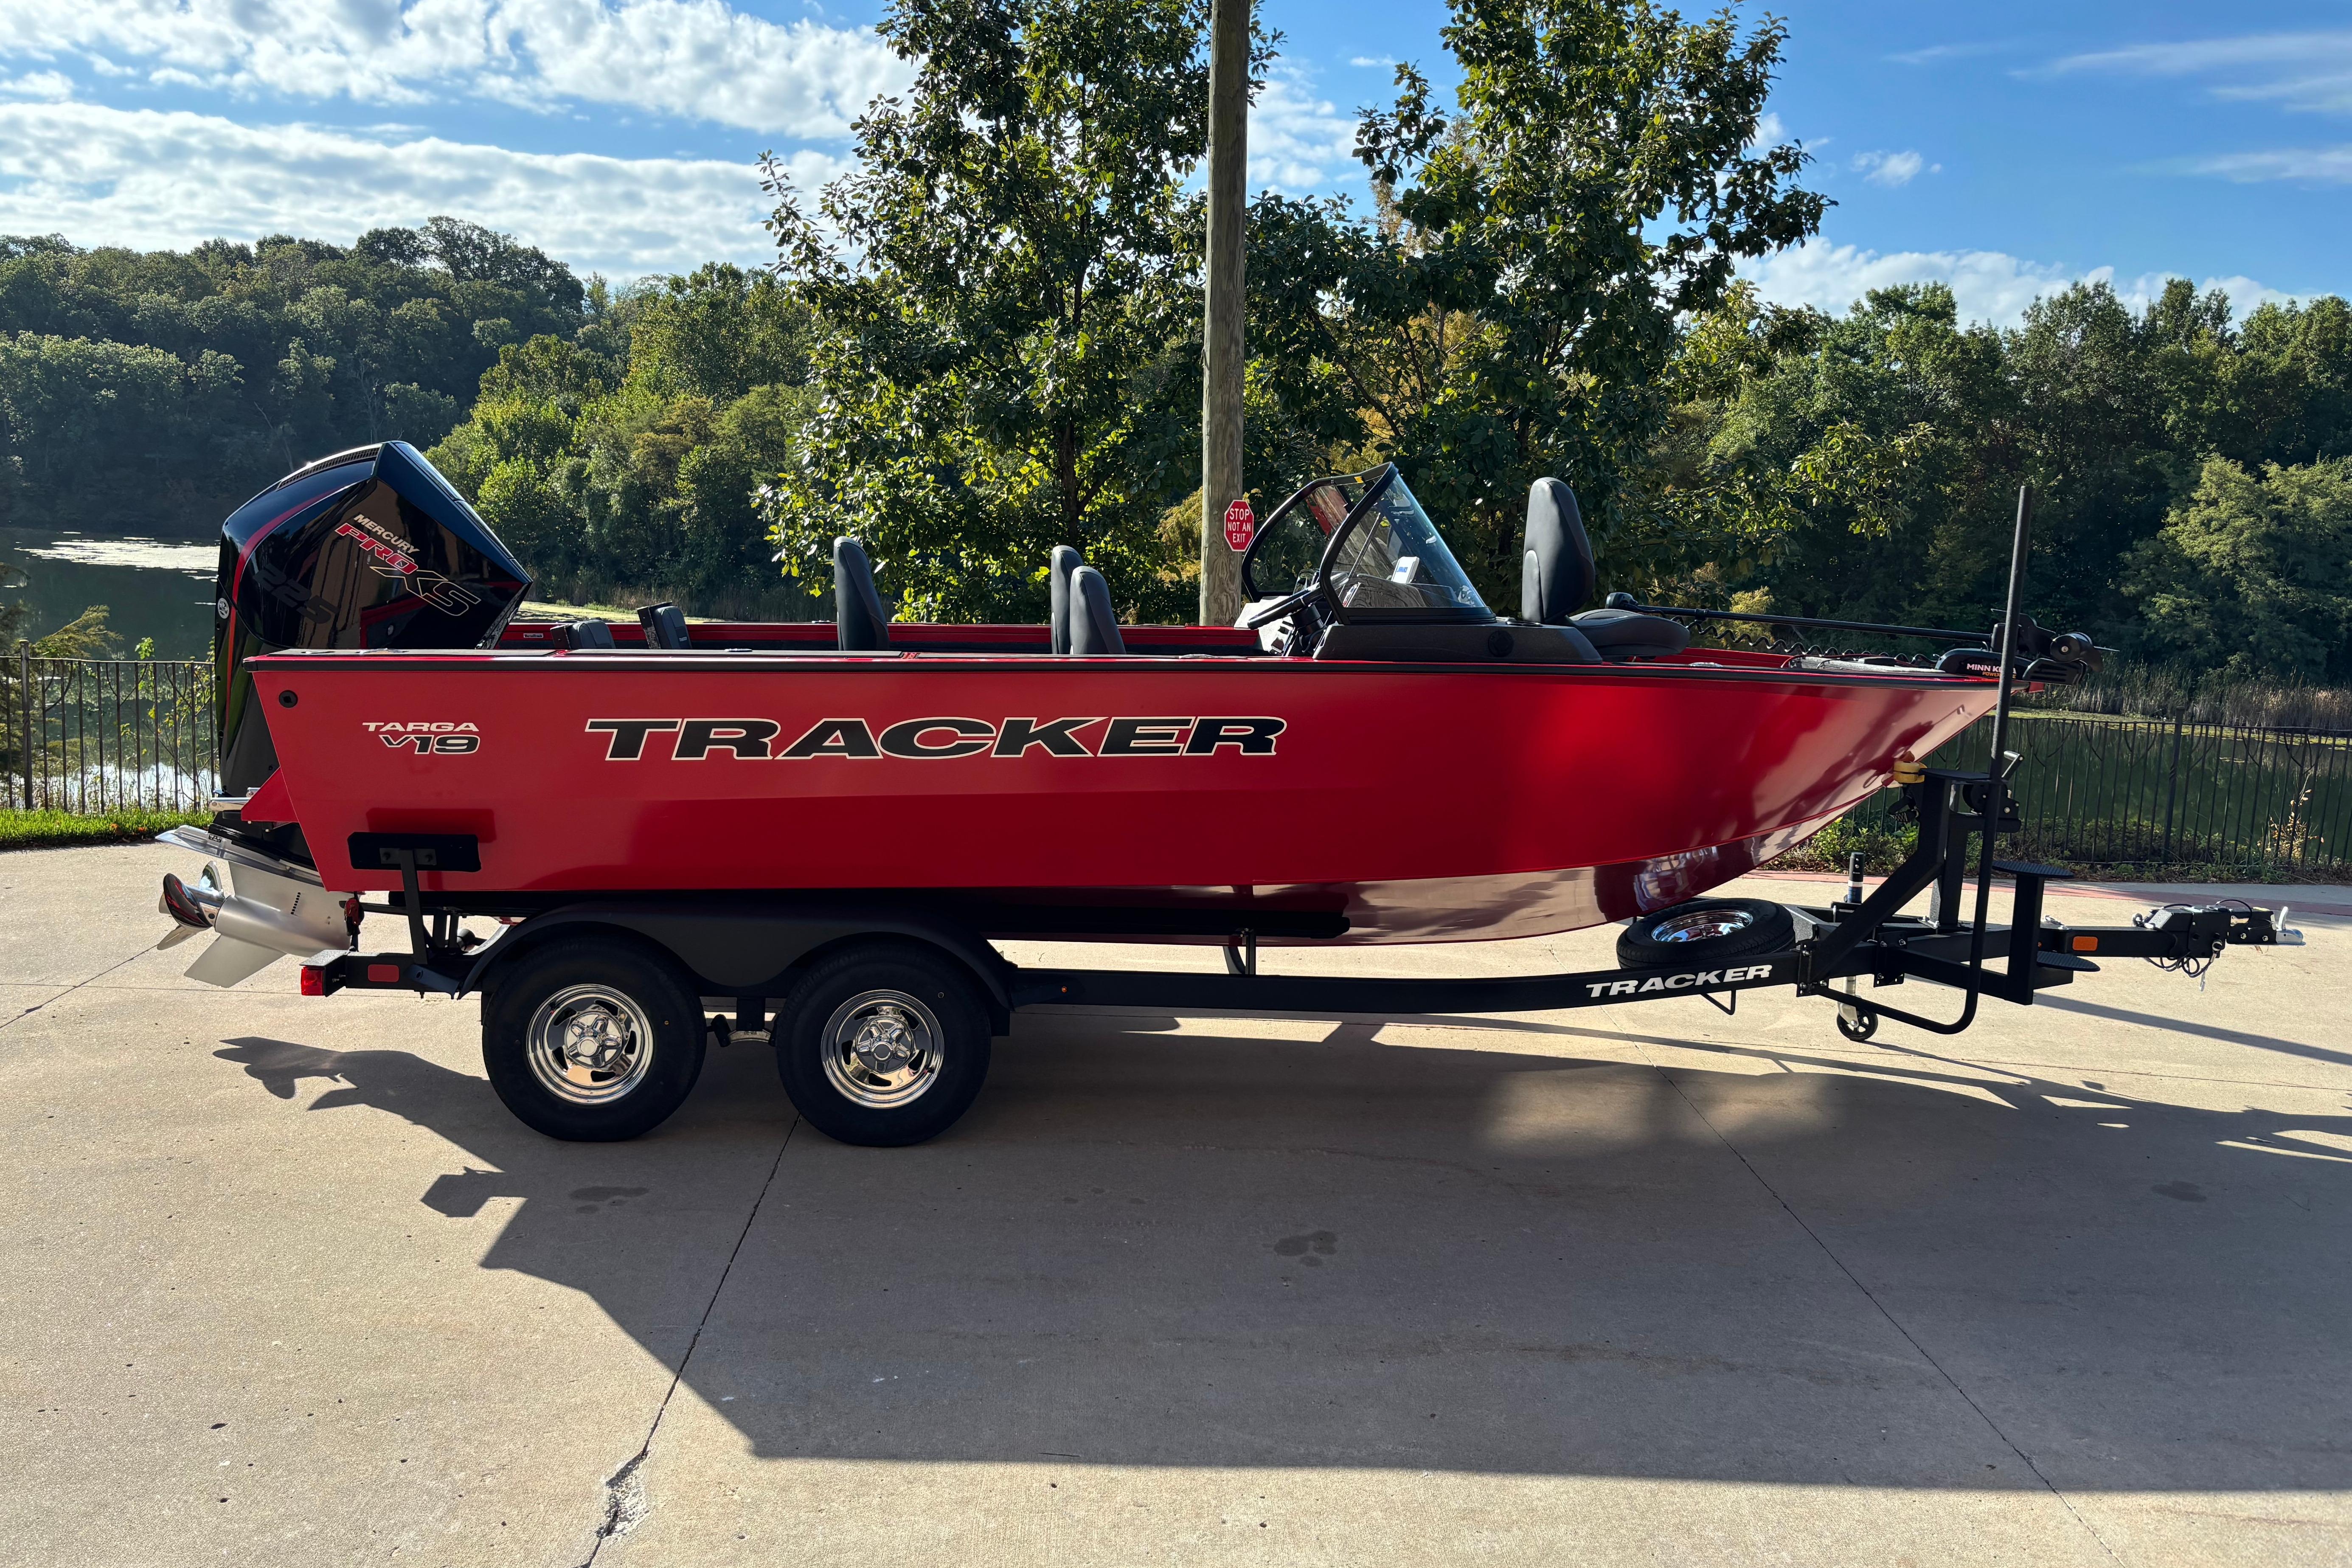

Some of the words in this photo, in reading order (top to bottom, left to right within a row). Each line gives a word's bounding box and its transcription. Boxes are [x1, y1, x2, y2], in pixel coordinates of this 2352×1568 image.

[1229, 508, 1250, 520] STOP
[354, 514, 420, 554] MERCURY
[1228, 522, 1240, 531] NOT
[1242, 522, 1251, 531] AN
[1233, 533, 1245, 542] EXIT
[334, 523, 418, 575] PRO
[253, 563, 340, 624] 225
[1967, 663, 1991, 672] MINN
[362, 722, 479, 732] TARGA
[379, 734, 481, 755] V19
[584, 717, 1288, 760] TRACKER
[1585, 964, 1773, 998] TRACKER
